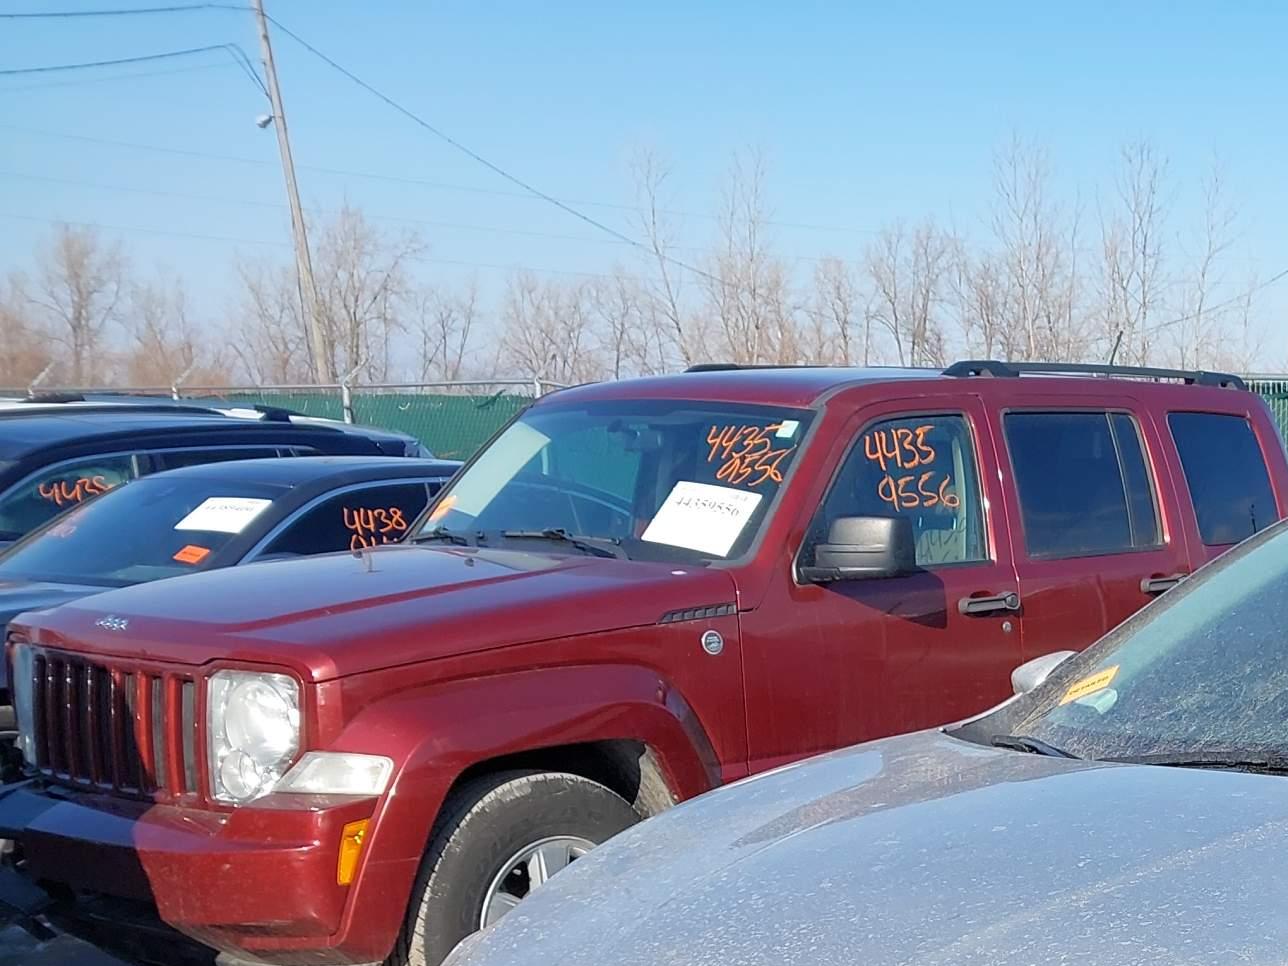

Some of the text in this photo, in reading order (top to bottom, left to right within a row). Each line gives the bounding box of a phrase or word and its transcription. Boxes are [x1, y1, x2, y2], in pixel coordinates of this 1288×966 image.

[706, 423, 784, 463] 4435
[863, 424, 937, 472] 4435
[715, 444, 797, 487] 9556
[877, 471, 961, 513] 9556
[342, 506, 408, 536] 4438
